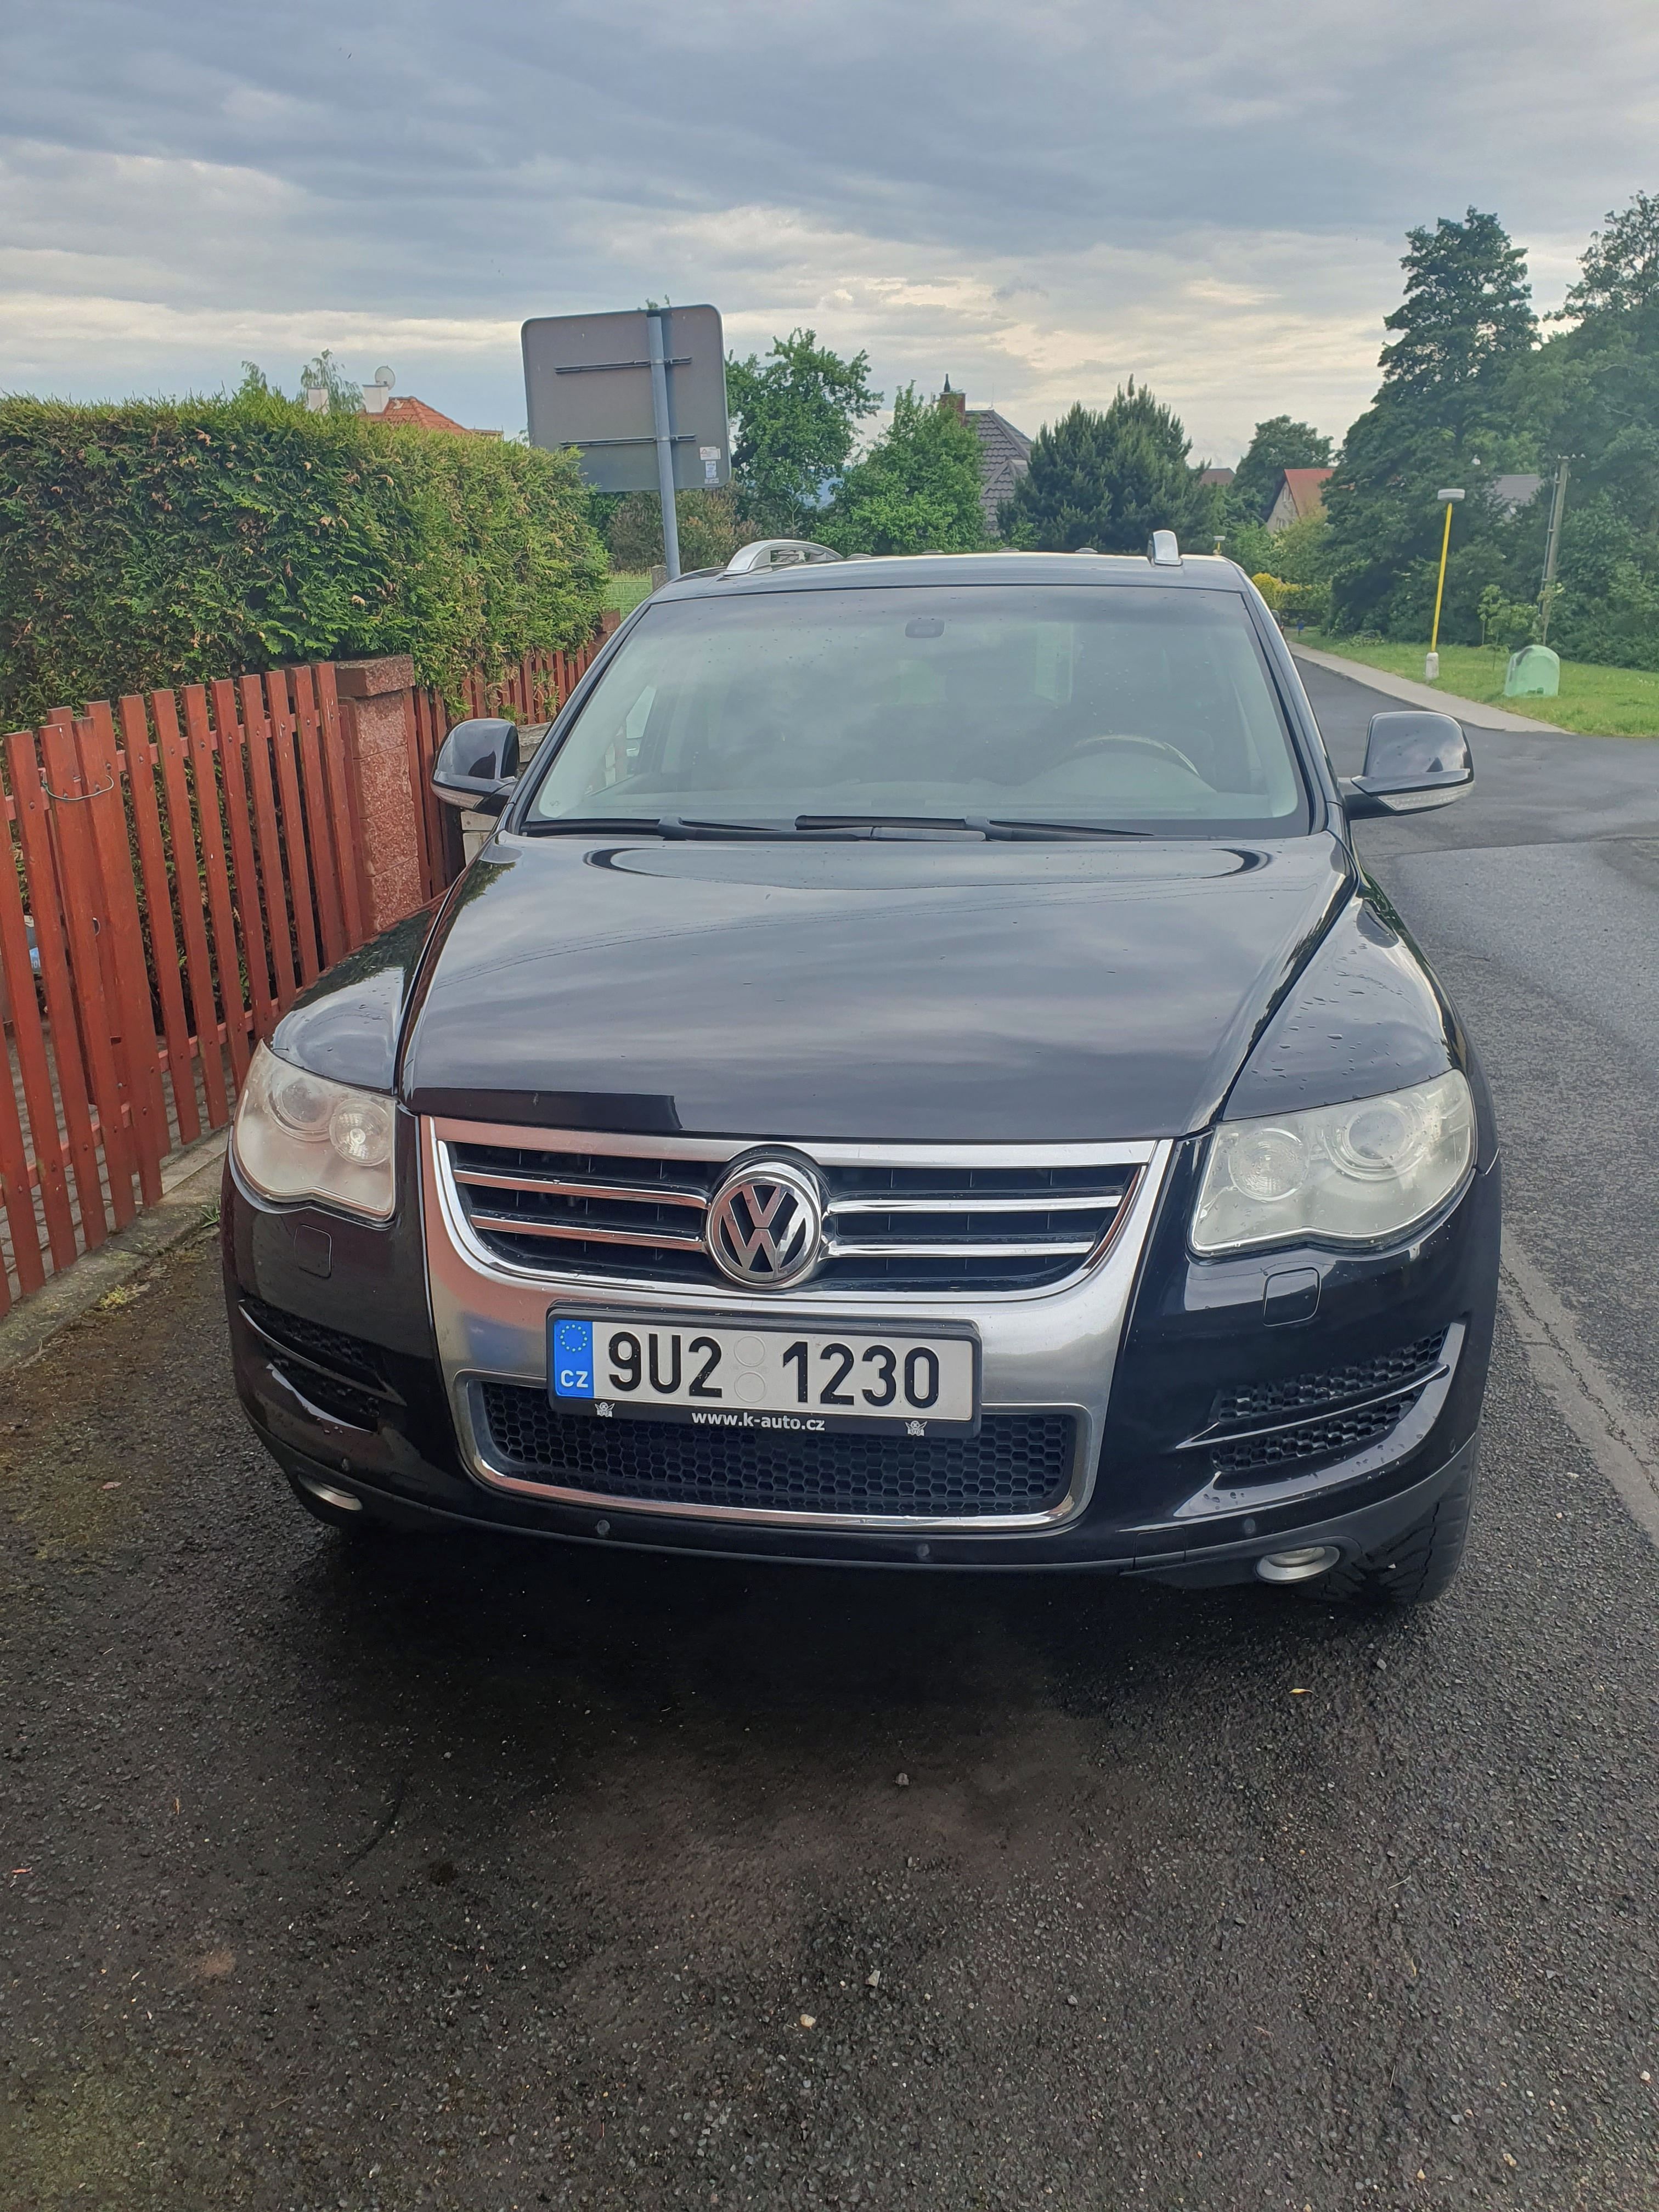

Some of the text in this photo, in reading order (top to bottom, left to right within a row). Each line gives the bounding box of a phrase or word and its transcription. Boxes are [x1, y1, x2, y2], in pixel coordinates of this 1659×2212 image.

[716, 1180, 810, 1276] VW
[561, 1369, 589, 1388] CZ
[609, 1331, 939, 1408] 9U2 1230
[691, 1412, 825, 1431] www.k-auto.cz
